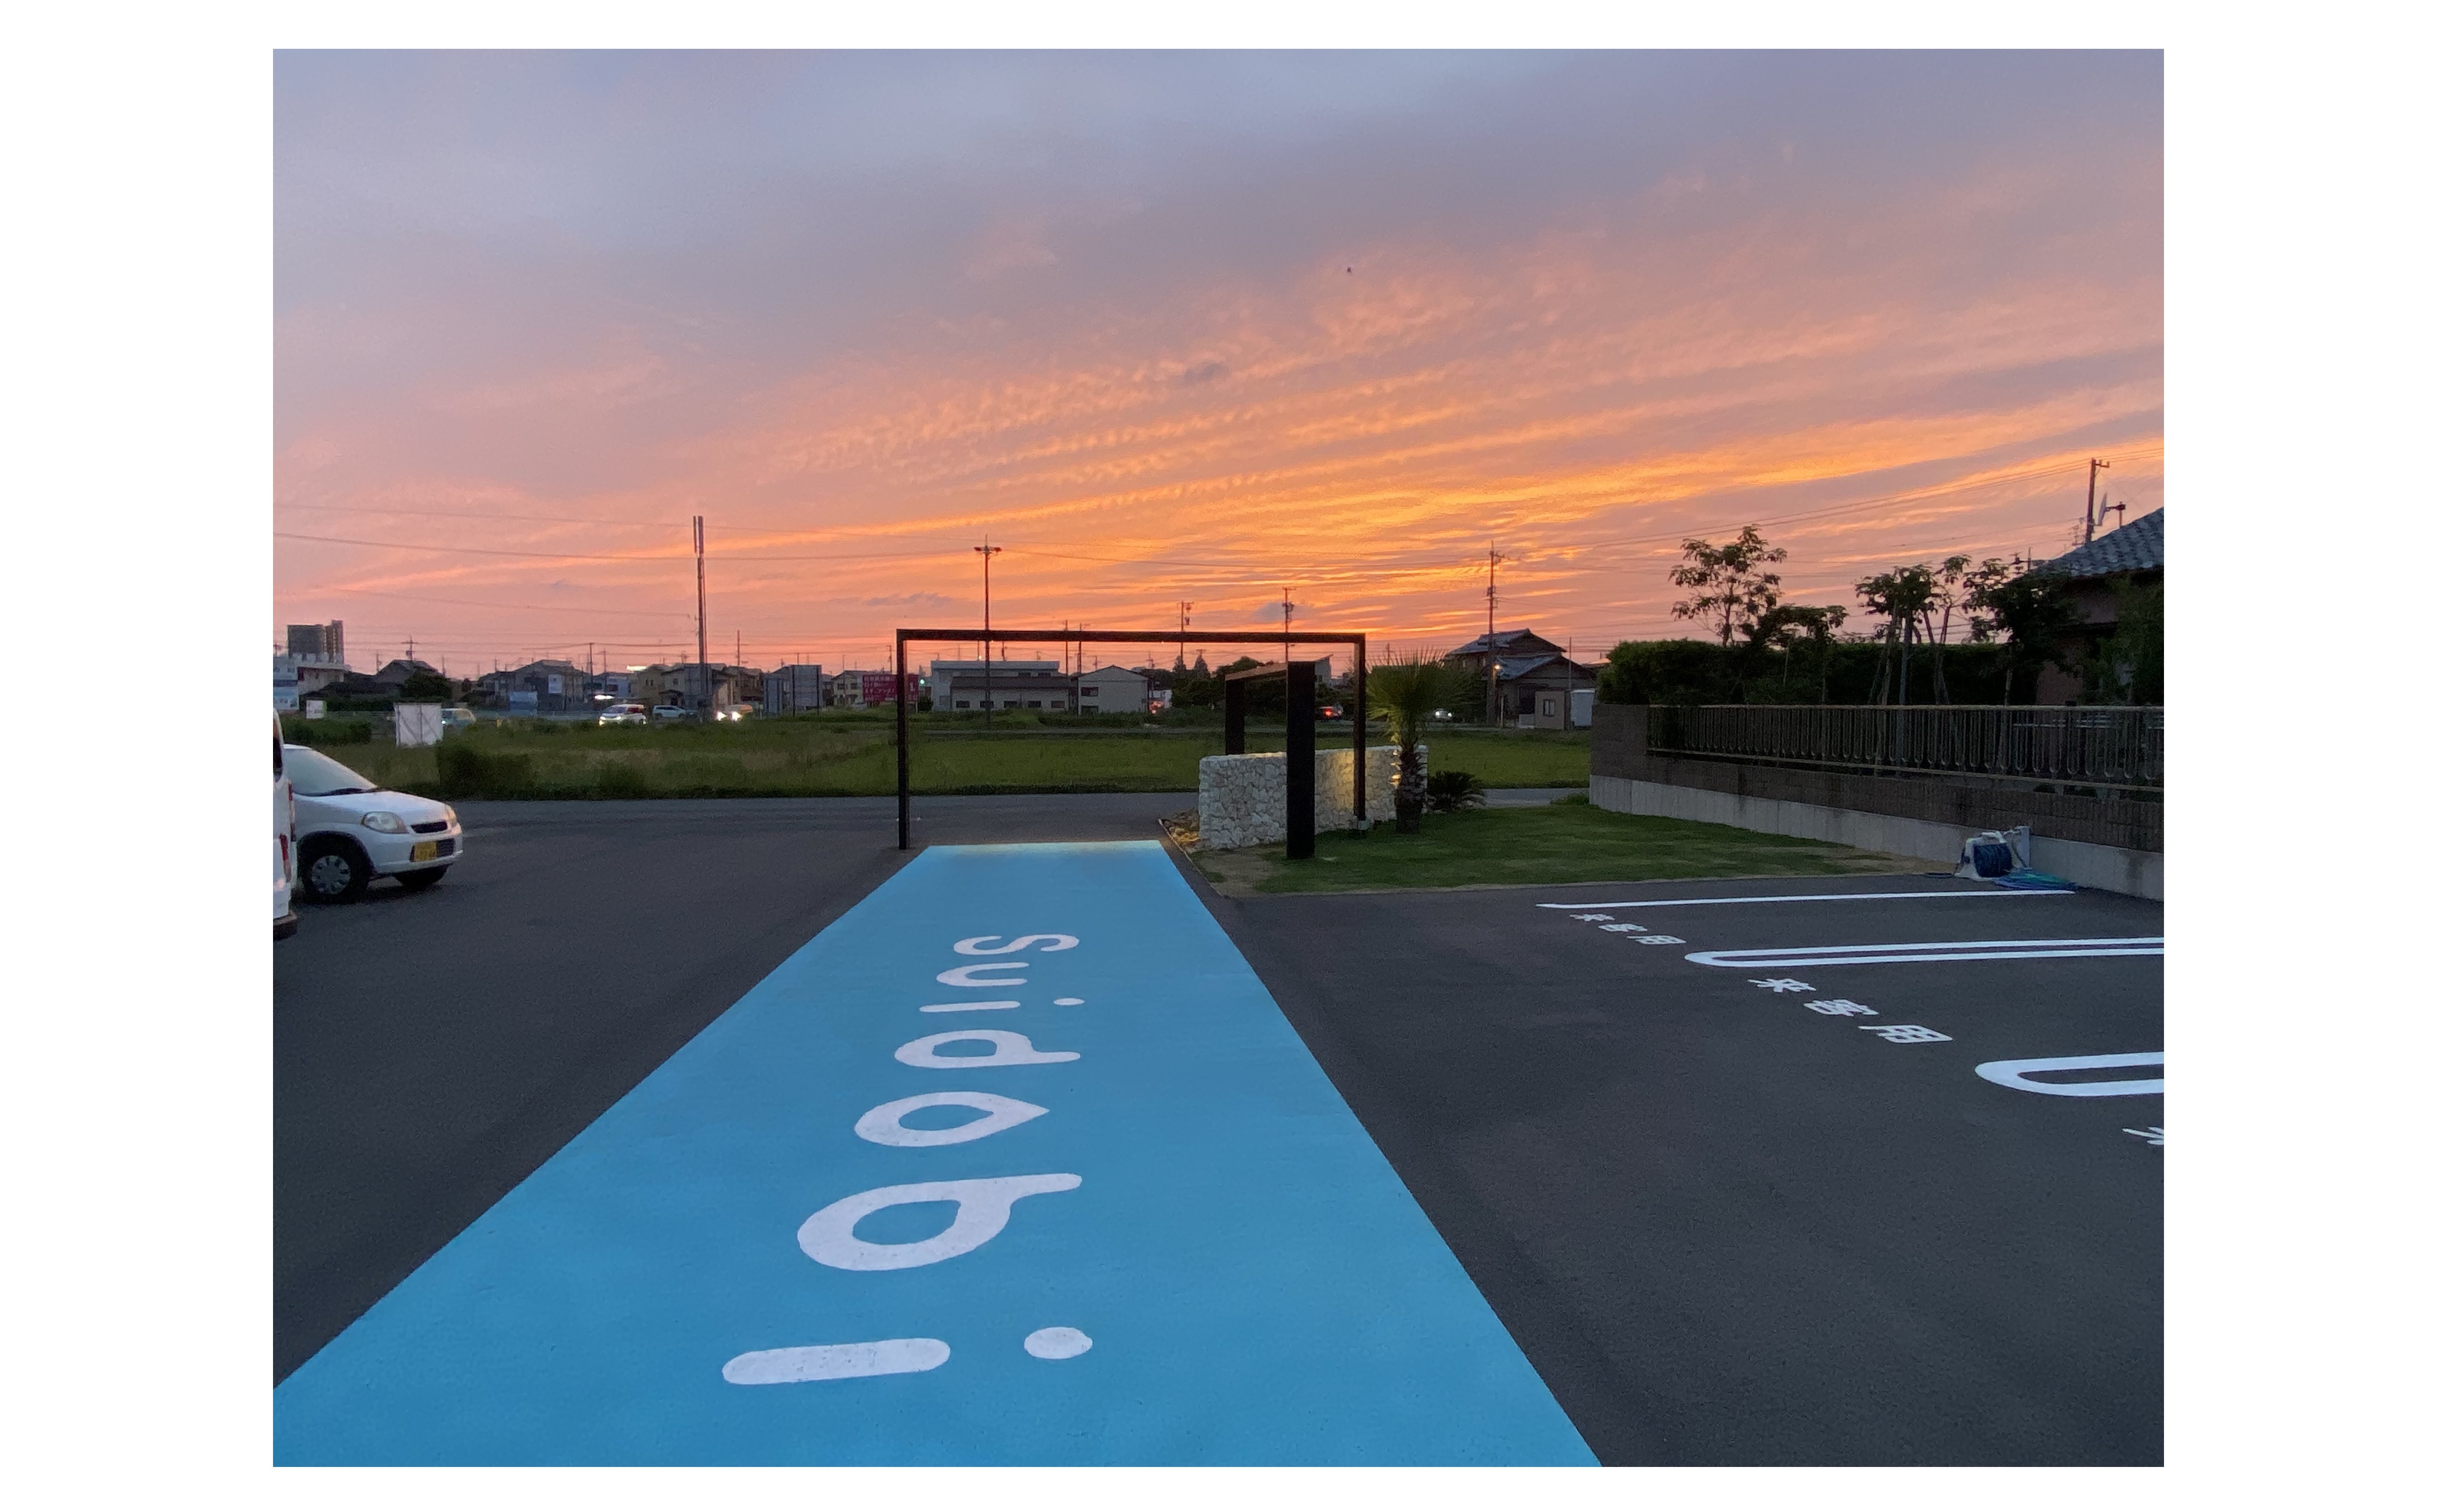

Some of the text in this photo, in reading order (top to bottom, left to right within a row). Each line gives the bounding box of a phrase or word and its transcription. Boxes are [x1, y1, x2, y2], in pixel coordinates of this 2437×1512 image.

[1569, 913, 1686, 945] 来客用
[1747, 978, 1954, 1043] 来客用
